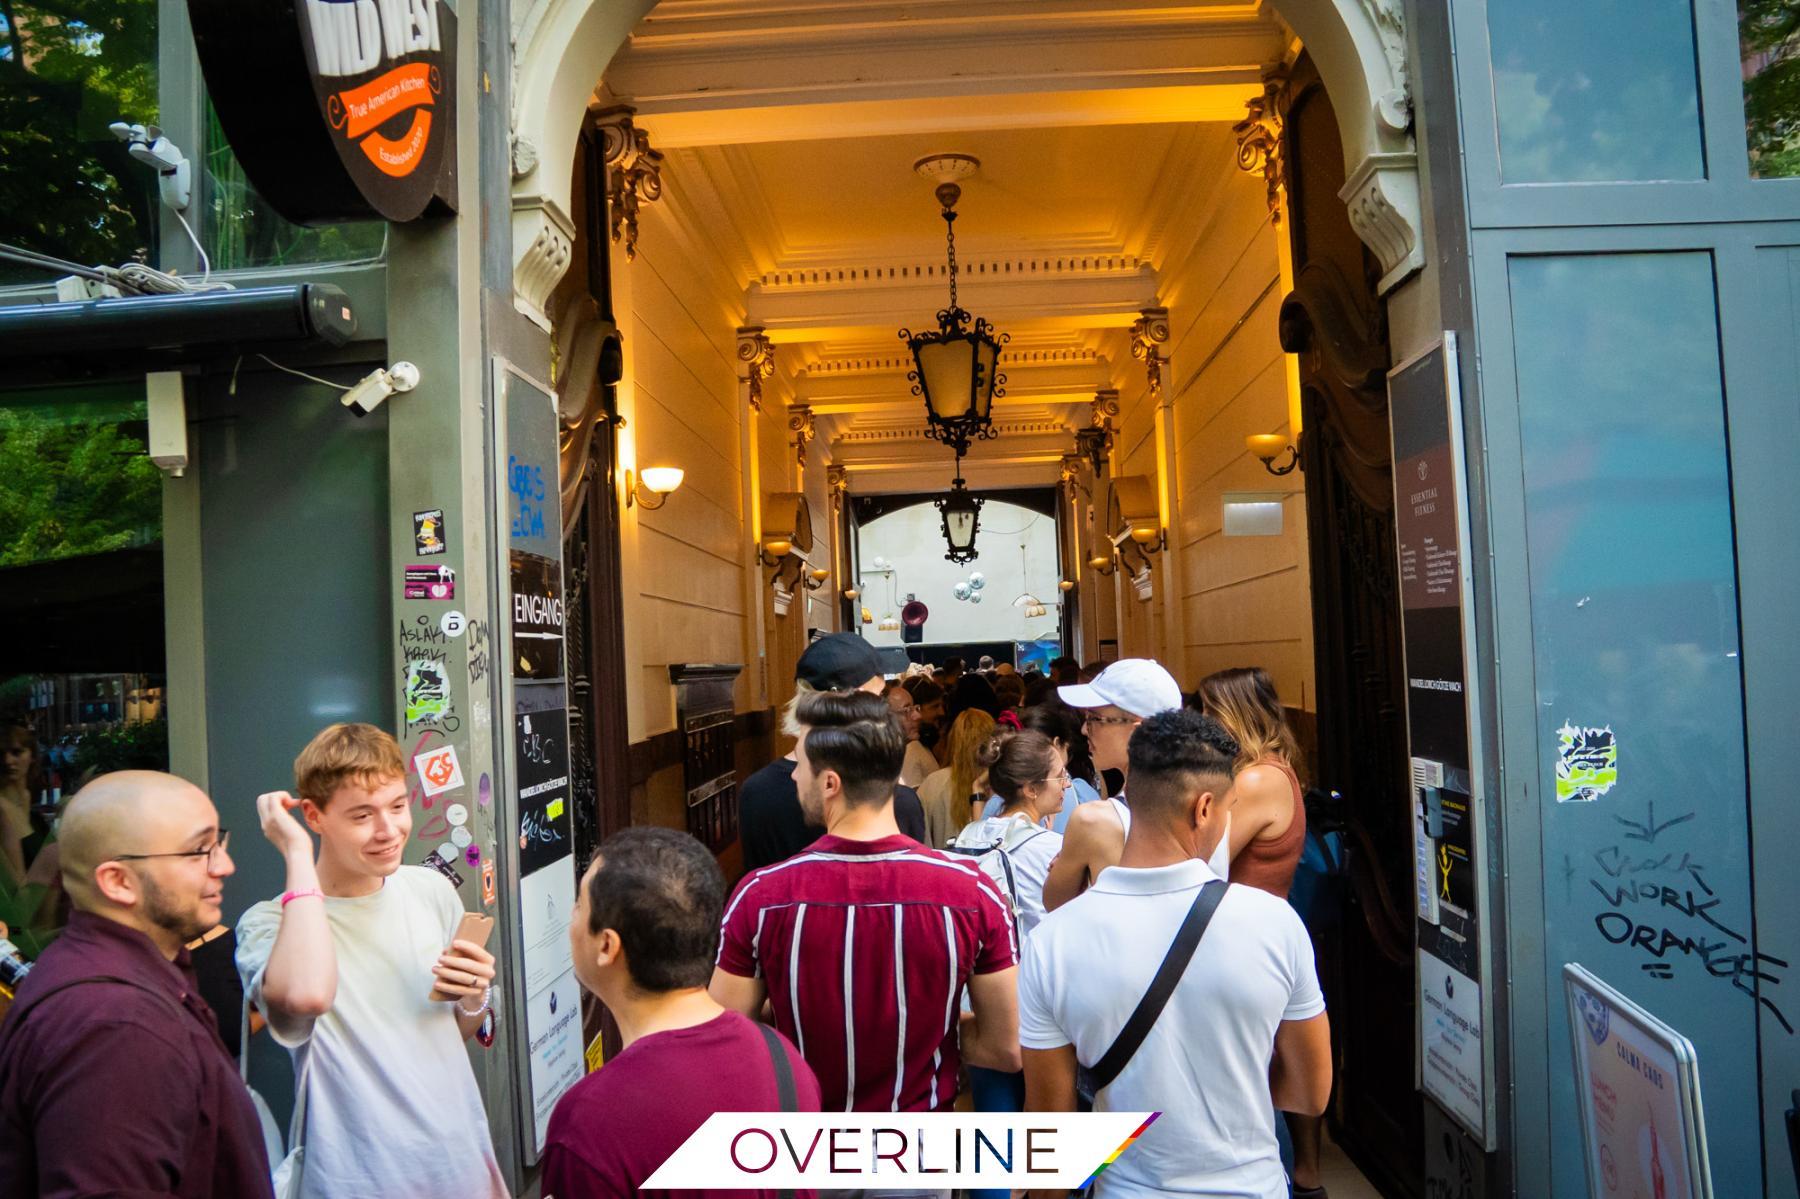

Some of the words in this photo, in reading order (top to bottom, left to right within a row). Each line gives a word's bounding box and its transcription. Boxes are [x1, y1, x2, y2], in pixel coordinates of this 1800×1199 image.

[349, 103, 368, 119] True
[368, 84, 400, 112] American
[399, 77, 425, 93] Kitchen
[1410, 487, 1438, 505] ESSENTIAL
[1414, 502, 1436, 517] FITNESS
[514, 593, 562, 626] EINGANG
[1590, 880, 1747, 944] WORK
[548, 1014, 570, 1038] Language
[1443, 1003, 1468, 1032] Language
